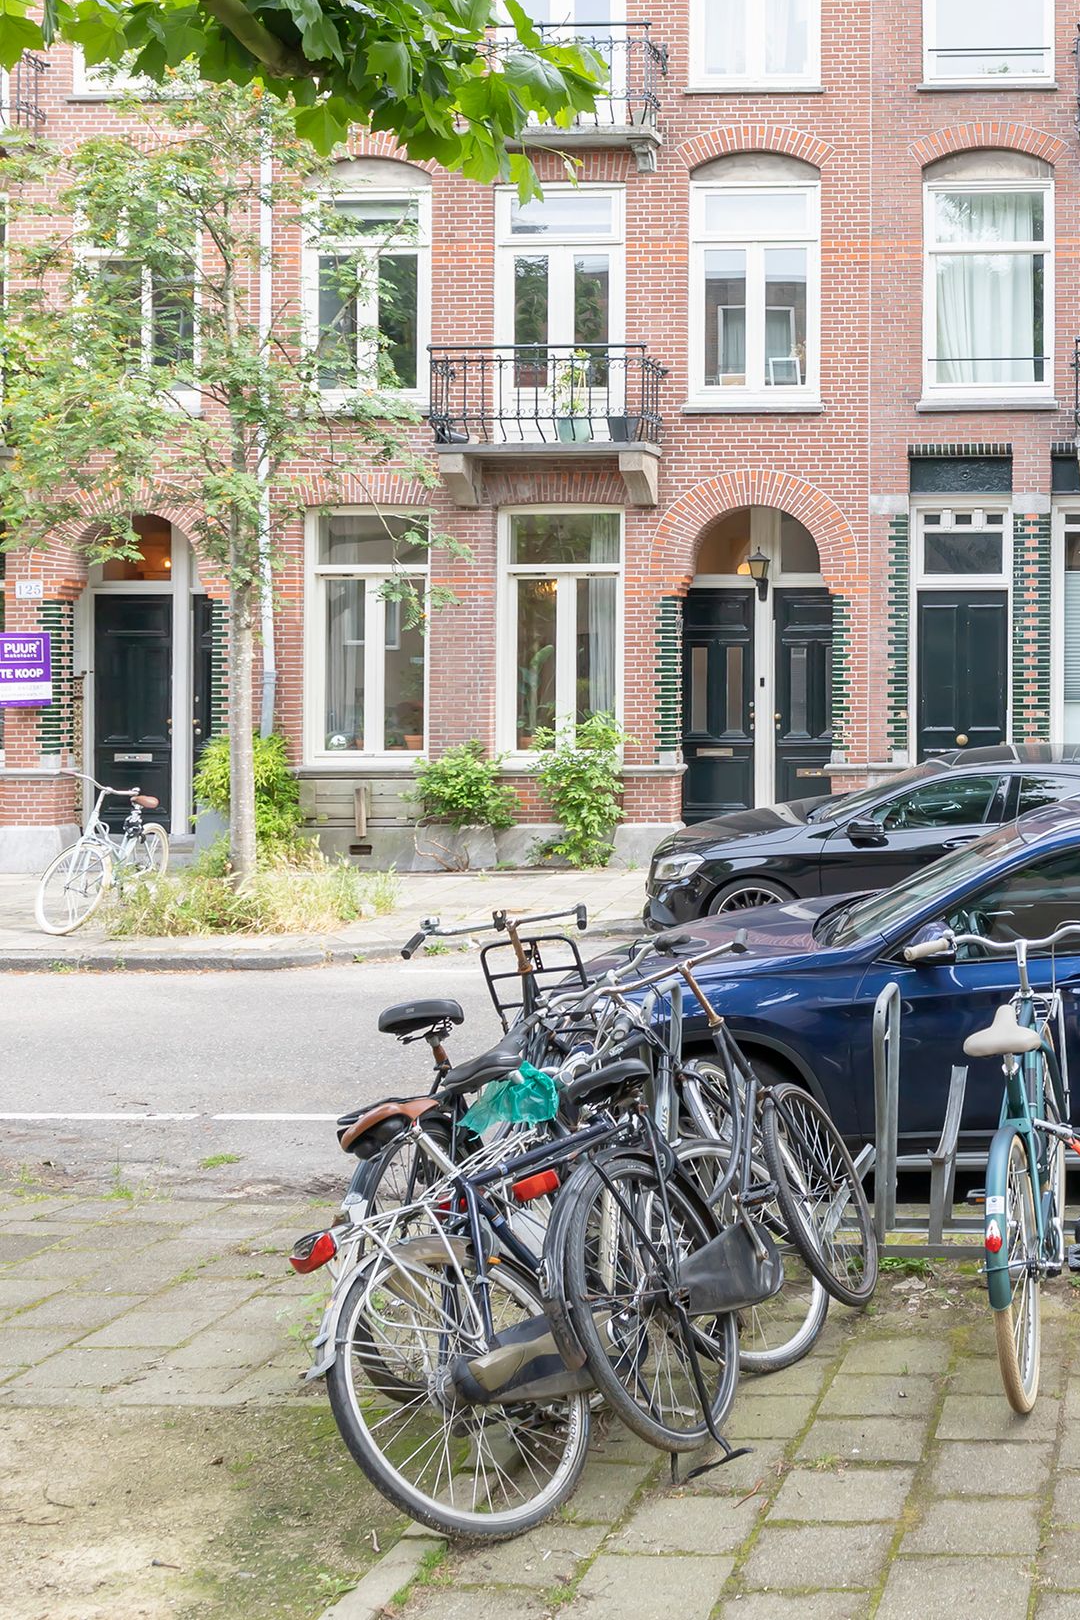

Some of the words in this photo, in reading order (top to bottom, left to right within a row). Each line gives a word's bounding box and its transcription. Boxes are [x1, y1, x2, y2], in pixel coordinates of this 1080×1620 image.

[18, 585, 41, 595] 125
[4, 643, 37, 654] PUUR
[0, 669, 13, 678] TE
[15, 668, 44, 678] KOOP
